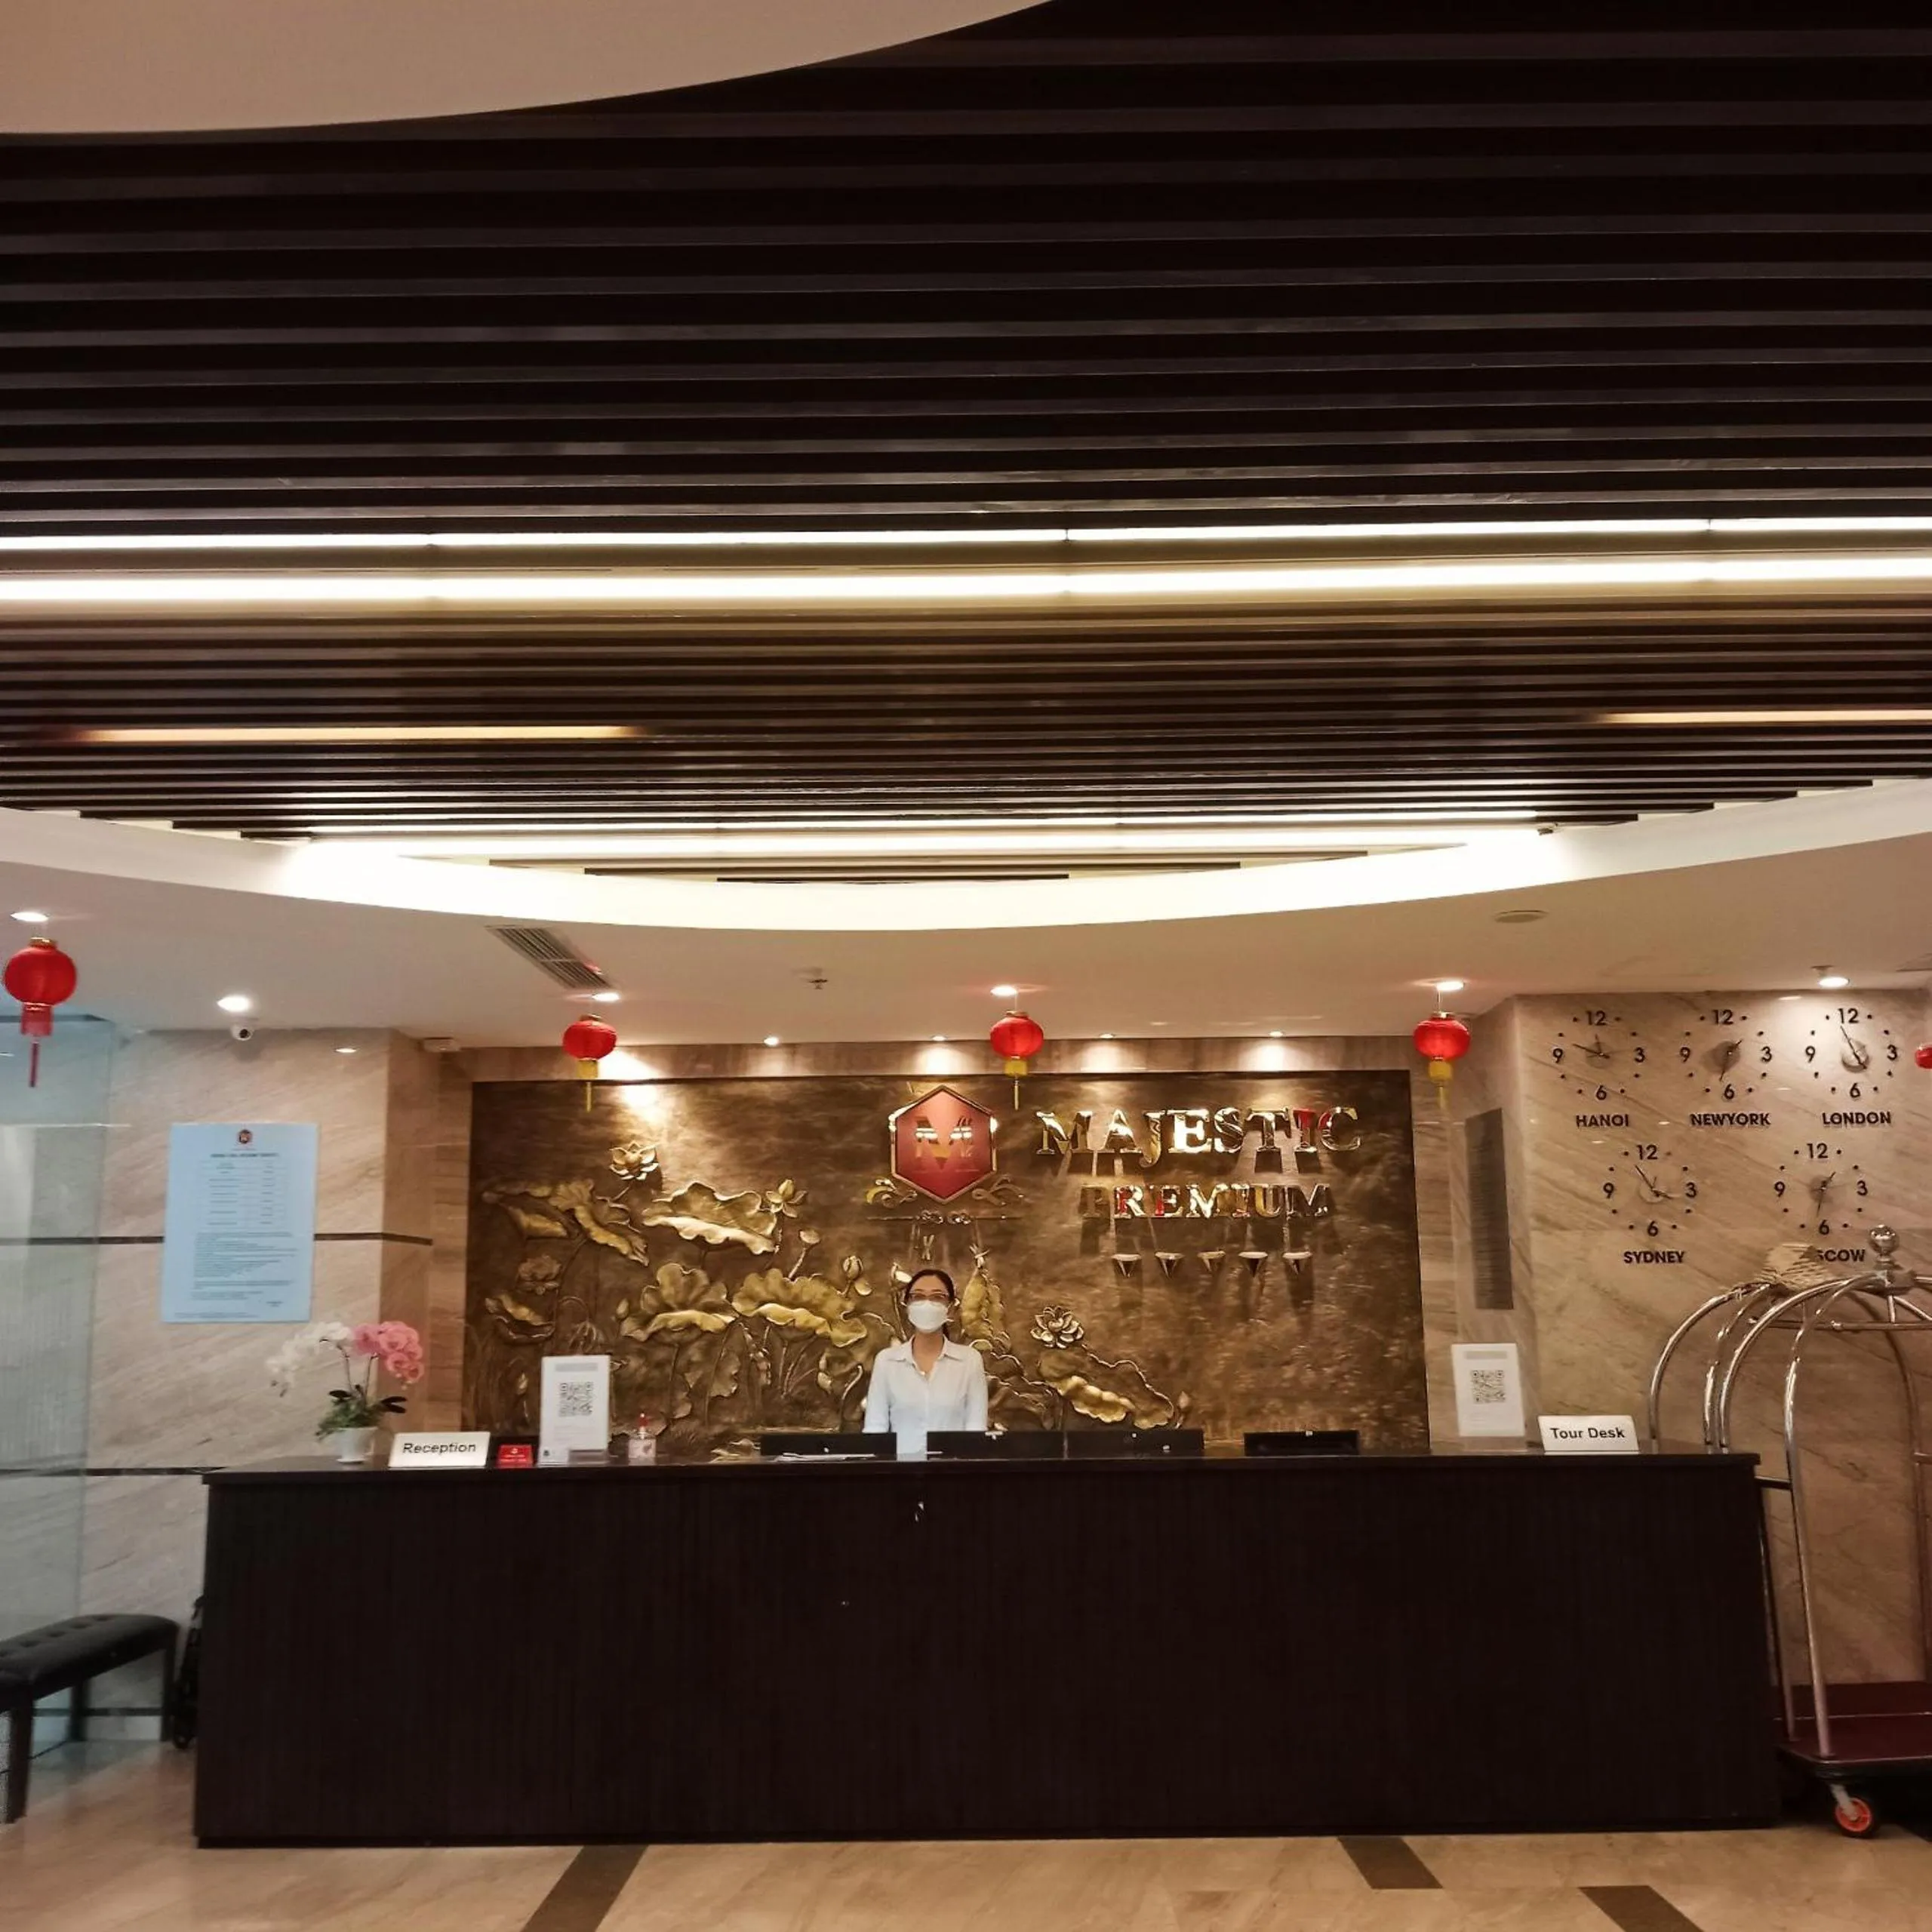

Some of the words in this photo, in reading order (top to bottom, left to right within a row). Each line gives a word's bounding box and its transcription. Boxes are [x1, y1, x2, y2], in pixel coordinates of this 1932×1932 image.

[1586, 1010, 1607, 1026] 12
[1710, 1009, 1734, 1026] 12
[1839, 1008, 1859, 1024] 12
[1552, 1047, 1564, 1063] 9
[1634, 1047, 1646, 1063] 3
[1679, 1046, 1691, 1063] 9
[1761, 1046, 1773, 1063] 3
[1805, 1046, 1816, 1063] 9
[1887, 1046, 1898, 1061] 3
[1595, 1085, 1607, 1101] 6
[1724, 1084, 1735, 1100] 6
[1850, 1083, 1860, 1098] 6
[1575, 1114, 1629, 1128] HANOI
[1690, 1112, 1770, 1127] NEWYORK
[1822, 1111, 1891, 1125] LONDON
[1035, 1106, 1361, 1166] MAJESTIC
[1637, 1144, 1658, 1161] 12
[1807, 1143, 1828, 1158] 12
[1603, 1182, 1614, 1198] 9
[1685, 1182, 1697, 1198] 3
[1774, 1181, 1786, 1197] 9
[1857, 1180, 1868, 1196] 3
[1078, 1183, 1331, 1218] PREMIUM
[1647, 1221, 1658, 1237] 6
[1819, 1220, 1830, 1235] 6
[1623, 1250, 1684, 1264] SYDNEY
[1815, 1247, 1866, 1263] SCOW
[1550, 1426, 1584, 1438] Tour
[1588, 1426, 1626, 1438] Desk
[402, 1441, 476, 1456] Reception
